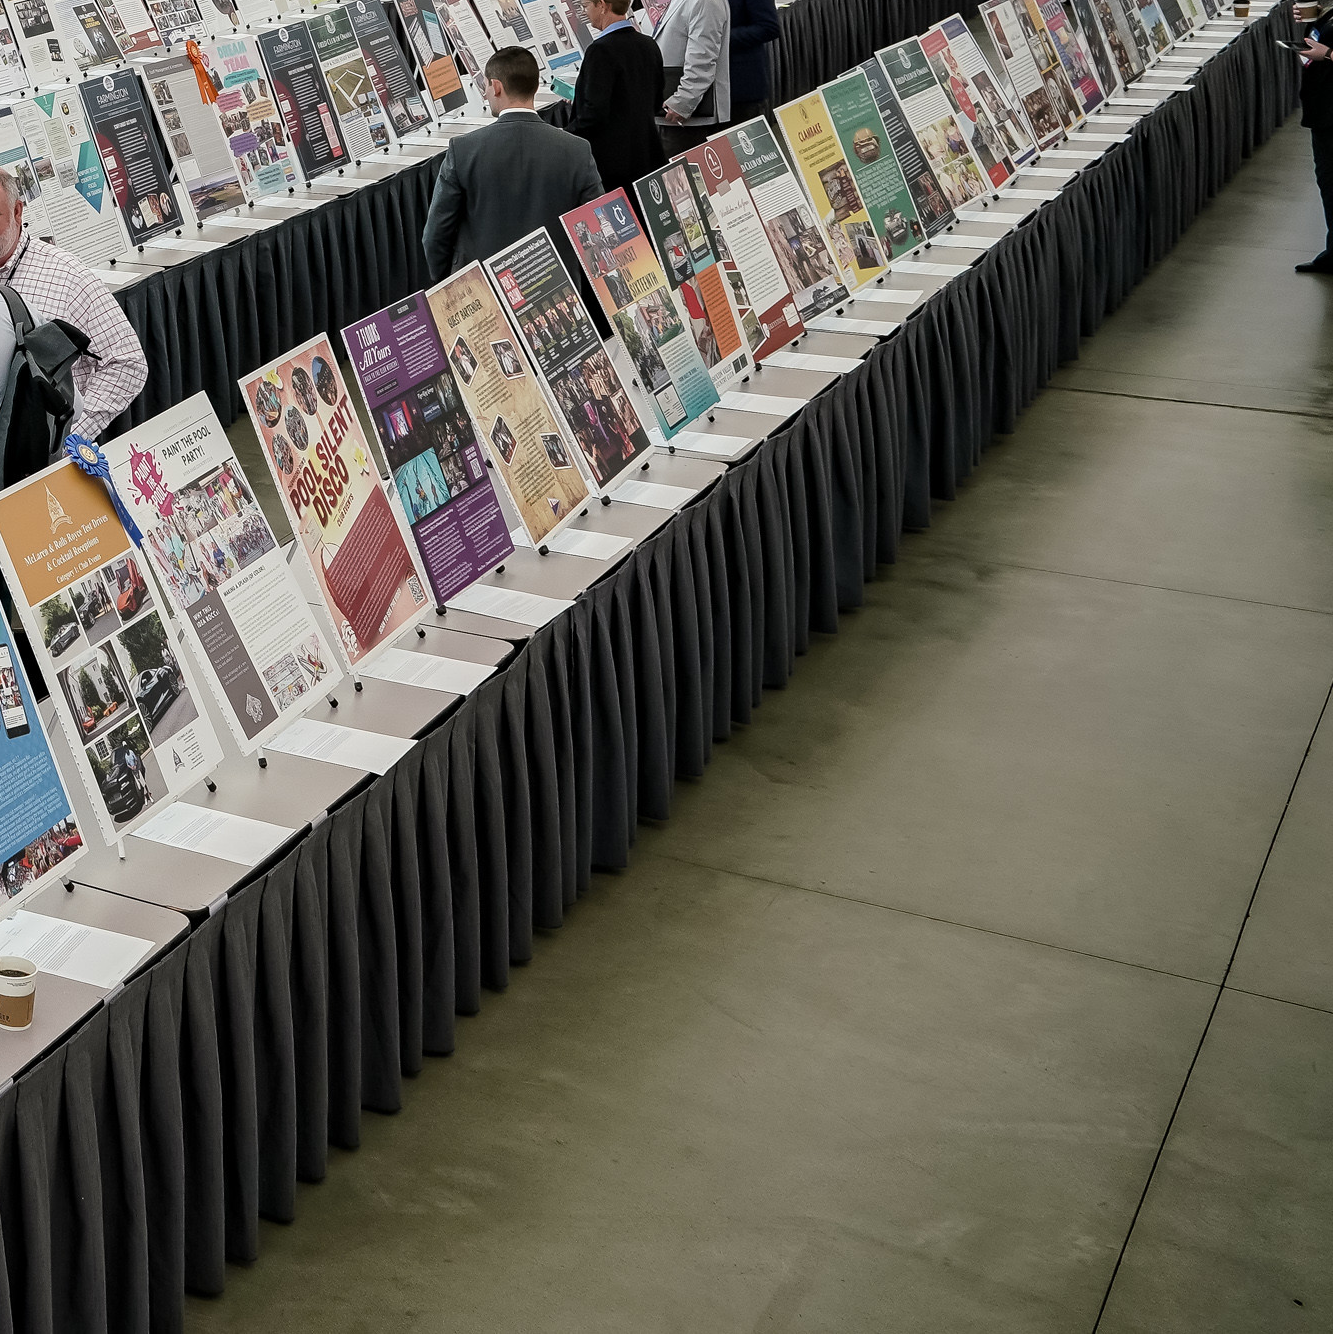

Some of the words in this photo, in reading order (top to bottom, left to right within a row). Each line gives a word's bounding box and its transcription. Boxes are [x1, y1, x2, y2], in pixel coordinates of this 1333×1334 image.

[215, 41, 249, 60] DREAM
[317, 41, 328, 49] FIELD
[222, 54, 251, 74] TEAM
[97, 87, 130, 107] FARMINGTON
[799, 123, 823, 143] CLAMBAKE
[615, 245, 637, 268] SUNSET
[623, 268, 633, 282] ON
[629, 271, 659, 298] SIXTEENTH
[355, 330, 363, 349] 7
[361, 322, 381, 348] FLOORS
[359, 349, 374, 371] All
[371, 344, 391, 364] Yours
[162, 441, 182, 459] PAINT
[181, 435, 194, 448] THE
[192, 426, 211, 442] POOL
[182, 446, 205, 465] PARTY!
[289, 458, 323, 521] POOL
[315, 393, 355, 467] SILENT
[311, 453, 350, 530] DISCO
[25, 549, 49, 565] McLaren
[49, 544, 55, 553] &
[54, 537, 68, 550] Rolls
[66, 530, 83, 542] Royce
[81, 523, 93, 534] Test
[92, 515, 108, 528] Drives
